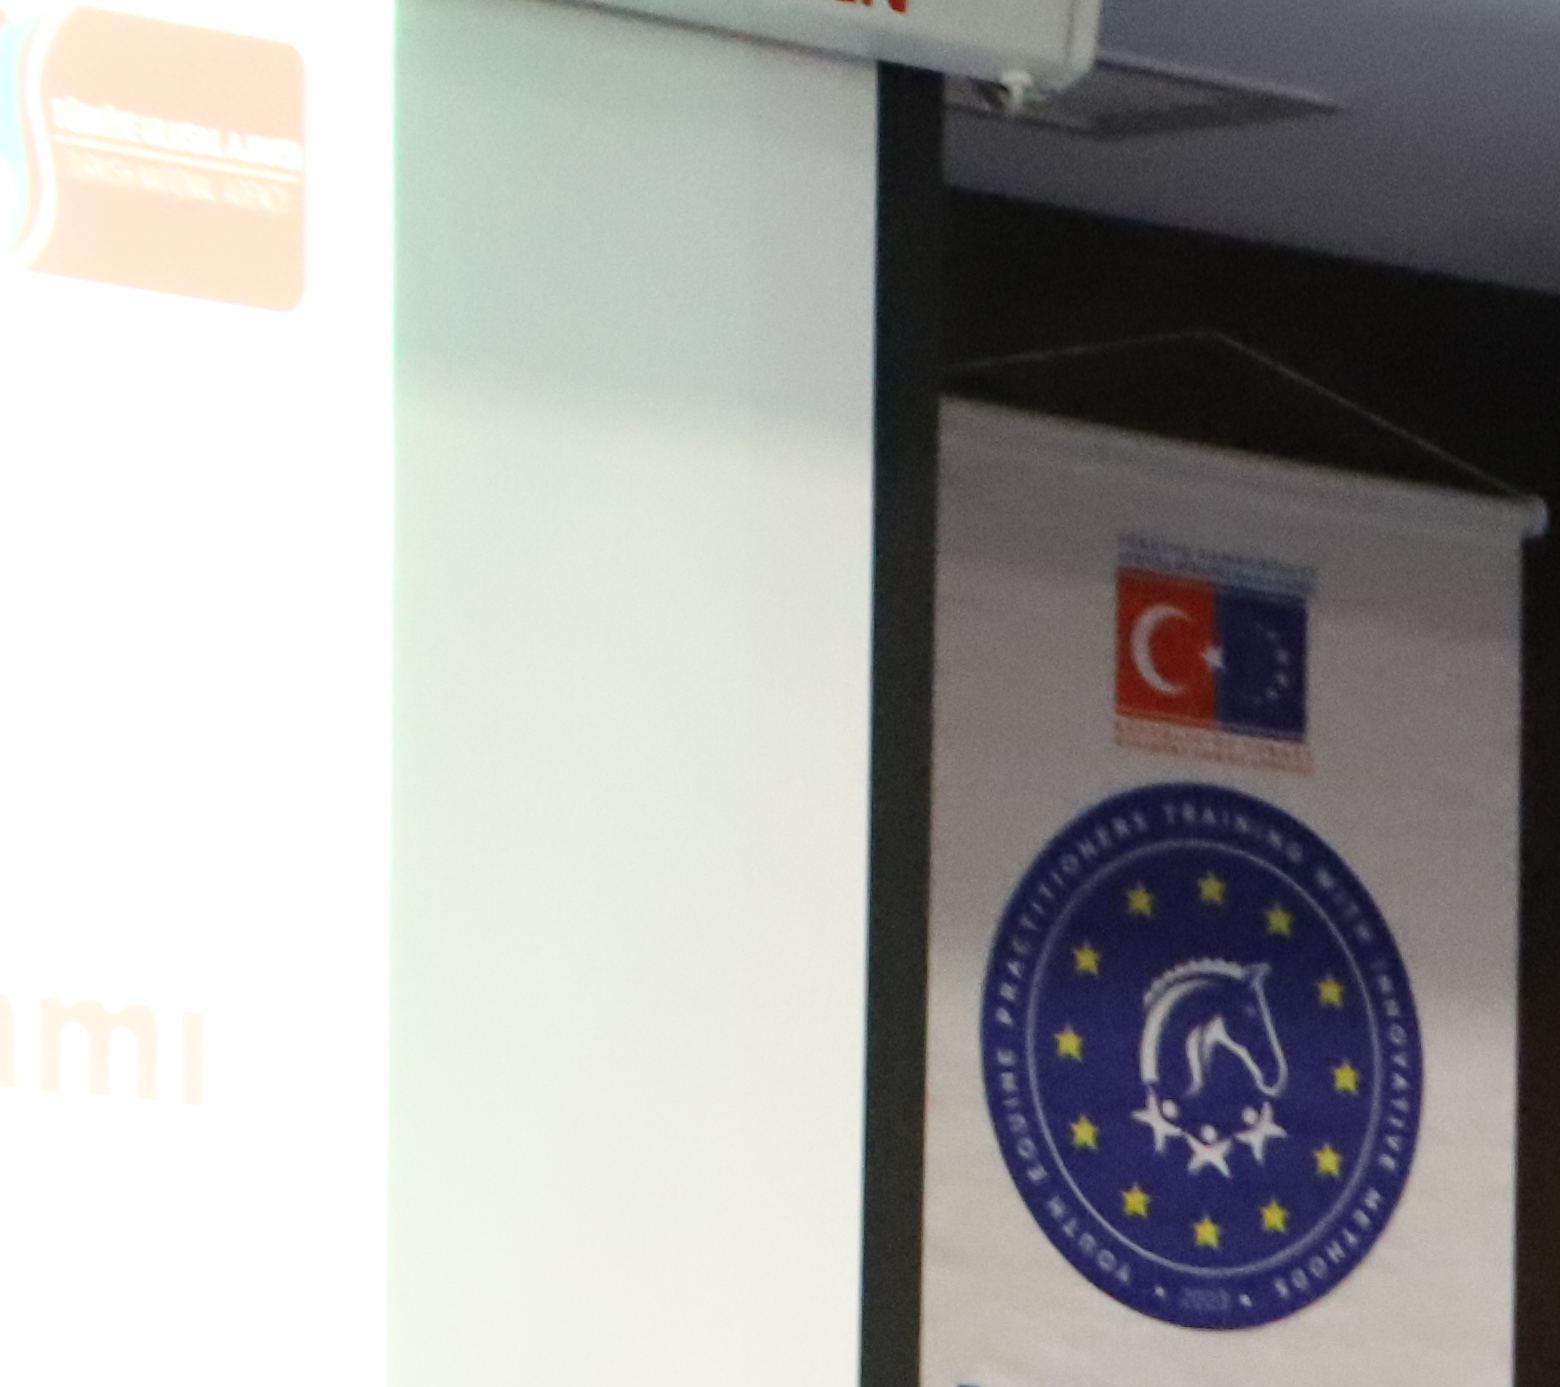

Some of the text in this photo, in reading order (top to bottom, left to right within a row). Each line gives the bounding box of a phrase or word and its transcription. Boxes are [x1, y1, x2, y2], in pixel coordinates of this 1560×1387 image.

[994, 805, 1150, 1027] PRACTITIONERS
[0, 993, 205, 1106] mı
[994, 1047, 1049, 1187] EQUINE
[1043, 1190, 1135, 1287] YOUTH
[1270, 1183, 1384, 1301] METHODS
